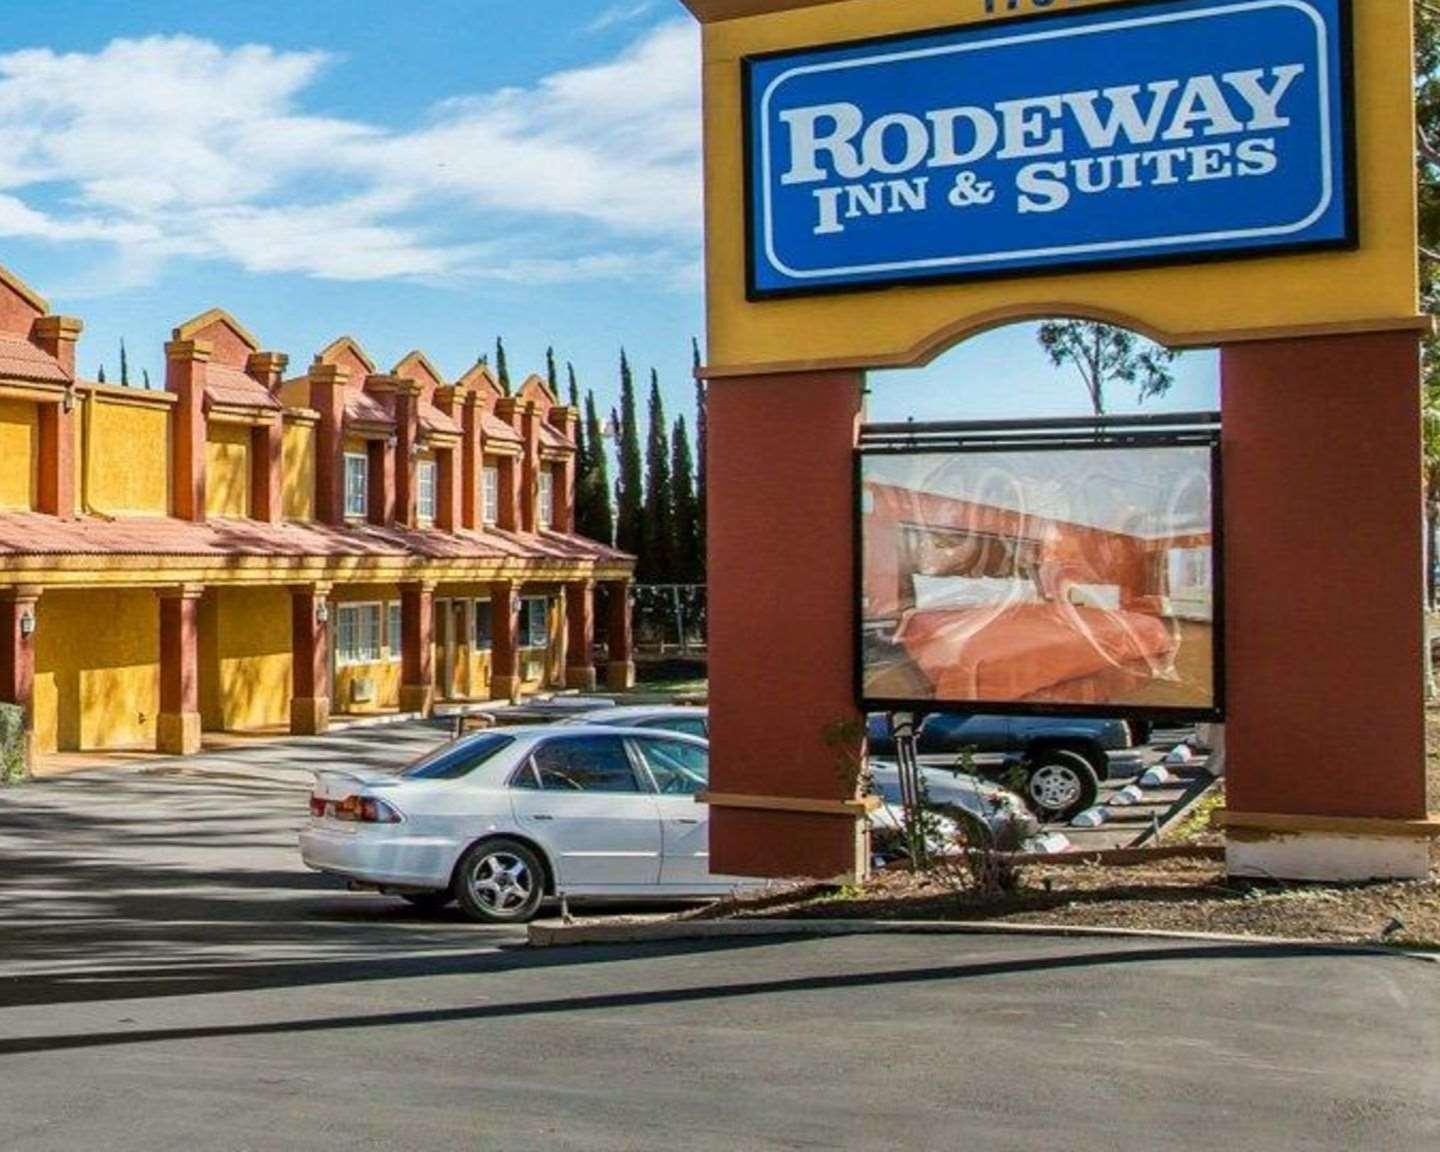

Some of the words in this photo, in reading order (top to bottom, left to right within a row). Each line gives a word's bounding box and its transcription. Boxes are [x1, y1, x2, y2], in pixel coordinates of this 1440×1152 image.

[779, 63, 1305, 185] RODEWAY
[812, 175, 929, 235] INN
[947, 170, 996, 207] &
[1016, 137, 1279, 215] SUITES
